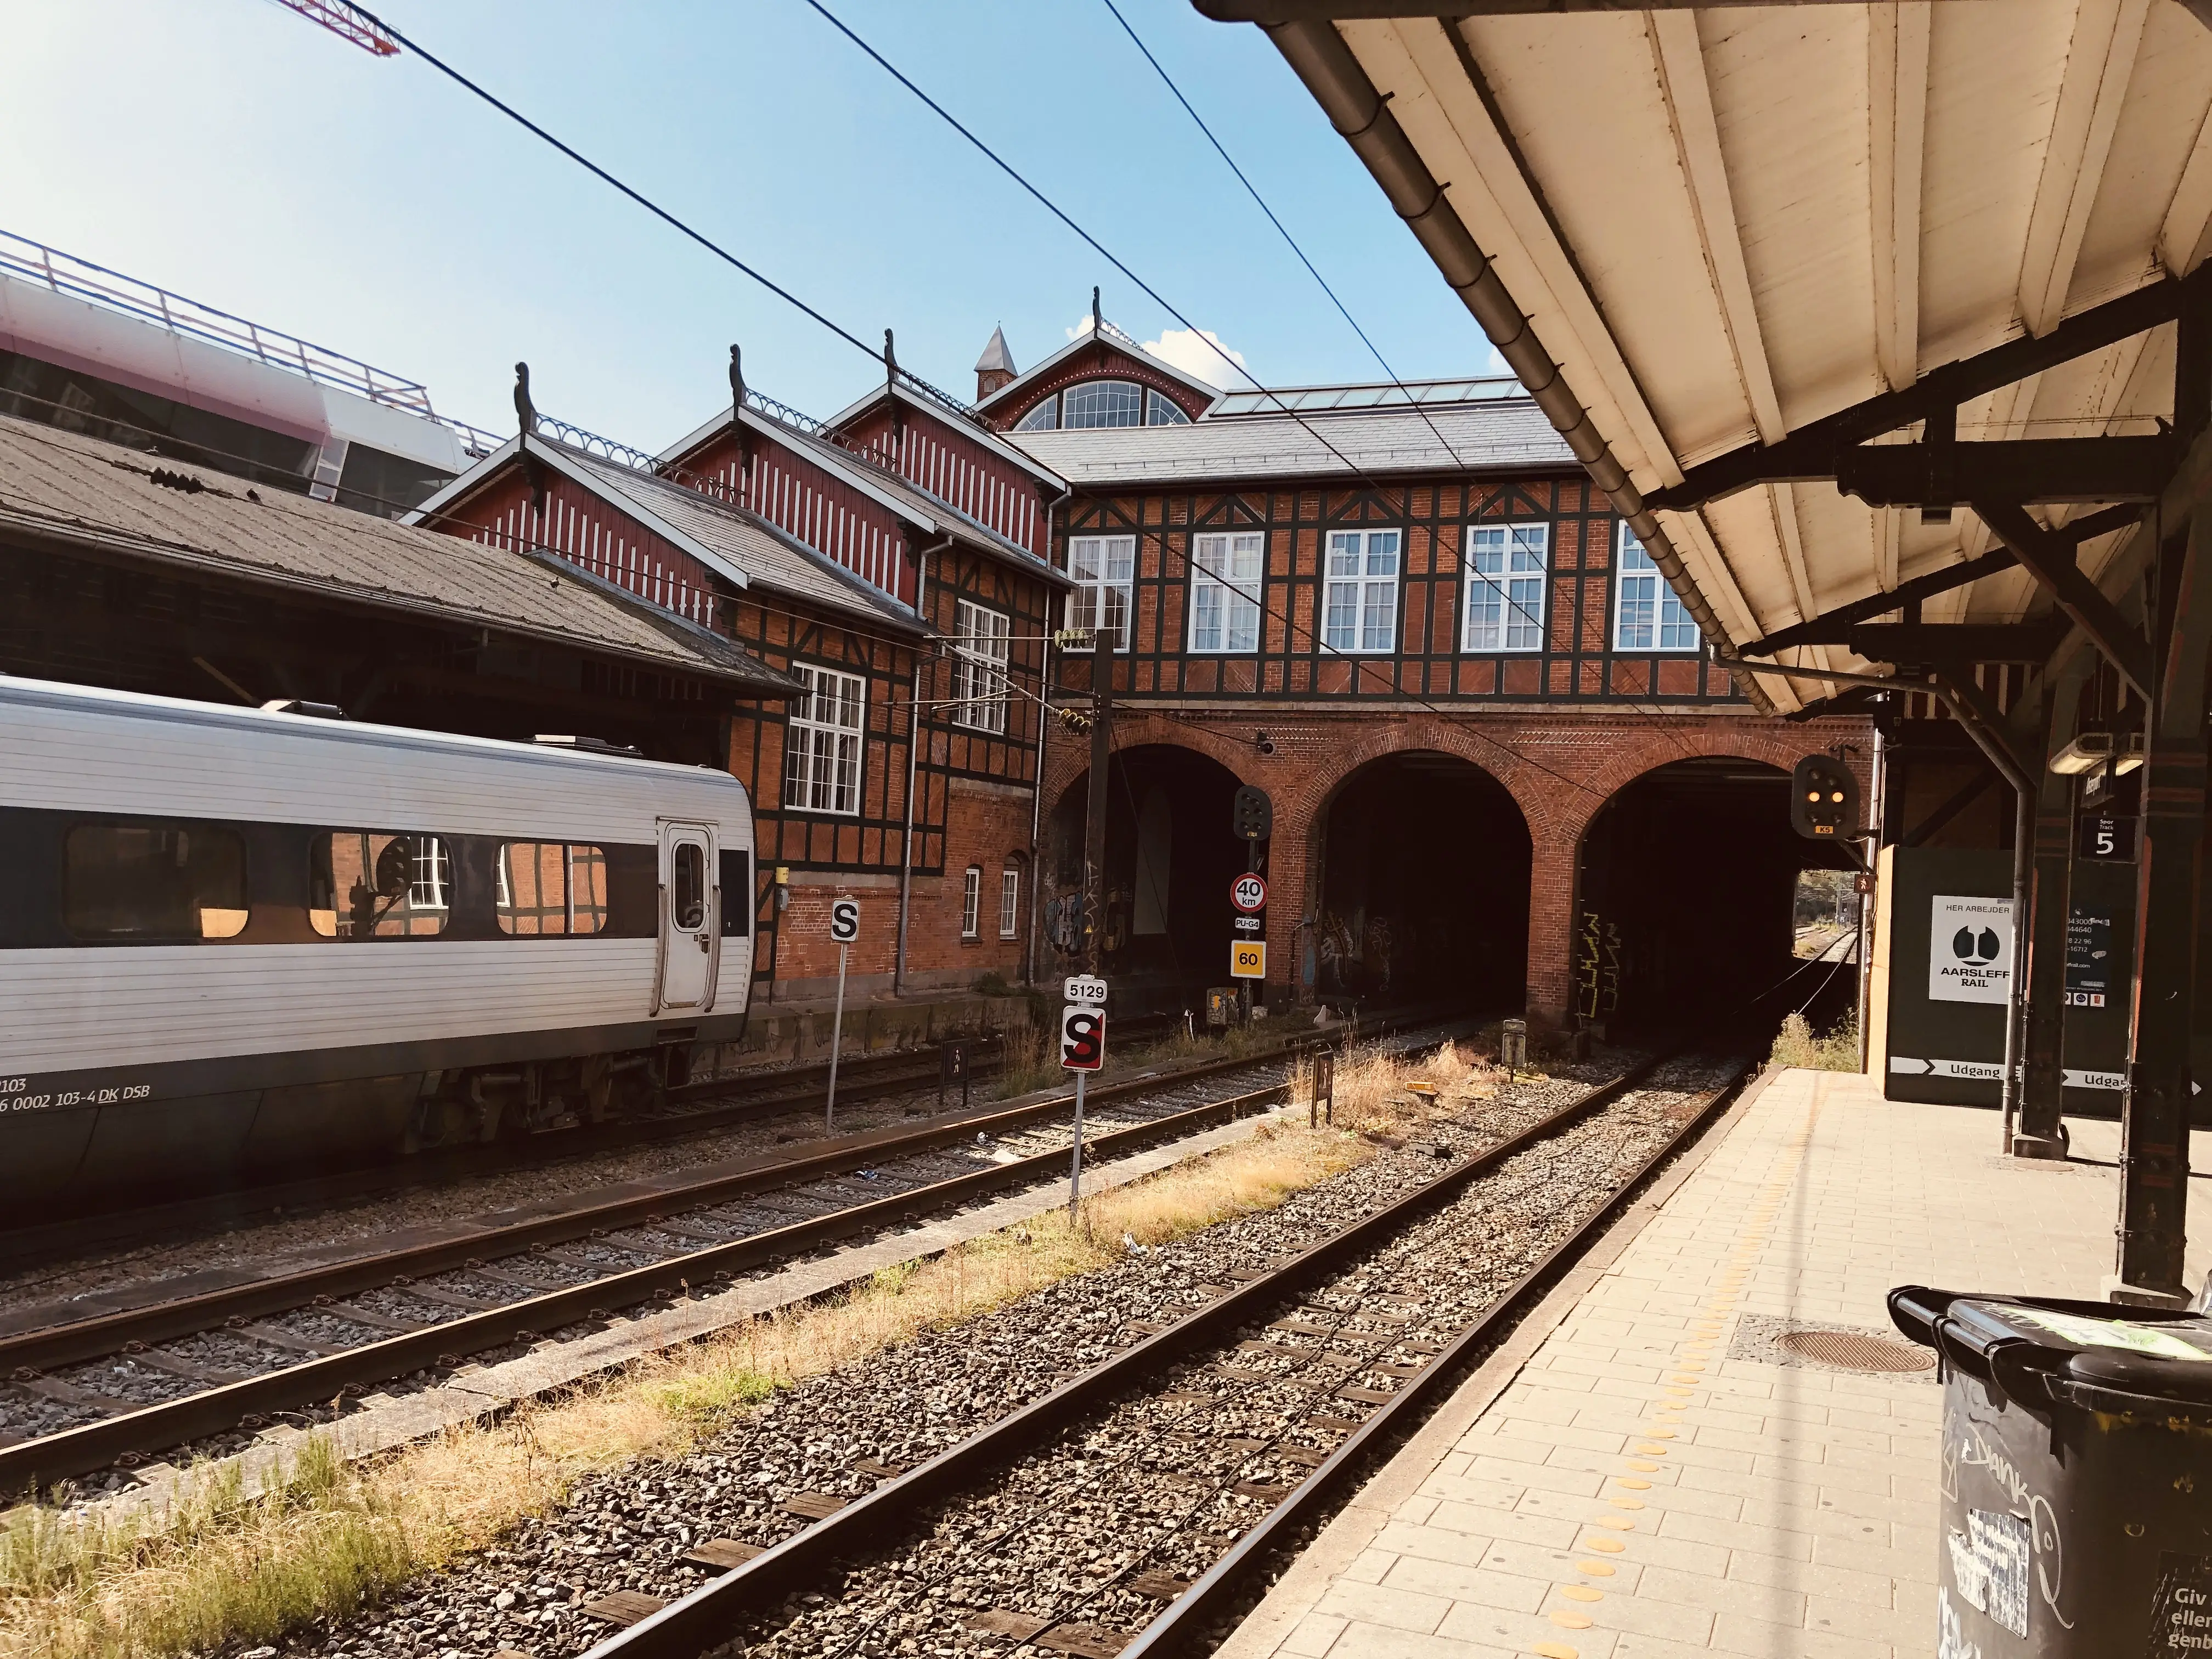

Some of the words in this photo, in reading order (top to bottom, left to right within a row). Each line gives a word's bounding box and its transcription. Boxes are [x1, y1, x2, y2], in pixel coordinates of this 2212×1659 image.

[2096, 833, 2114, 854] 5
[1237, 881, 1261, 896] 40
[832, 904, 857, 938] S
[1236, 919, 1259, 928] PU-G4
[1239, 952, 1258, 966] 60
[1941, 968, 2010, 978] AARSLEFF
[1961, 979, 1988, 987] RAIL
[1070, 985, 1104, 998] 5129
[1064, 1014, 1101, 1063] S
[1951, 1064, 2000, 1077] Udgang
[13, 1095, 50, 1110] 0002
[55, 1091, 95, 1106] 103-4
[98, 1088, 119, 1103] DK
[123, 1085, 150, 1099] DSB
[2175, 1588, 2207, 1605] Giv
